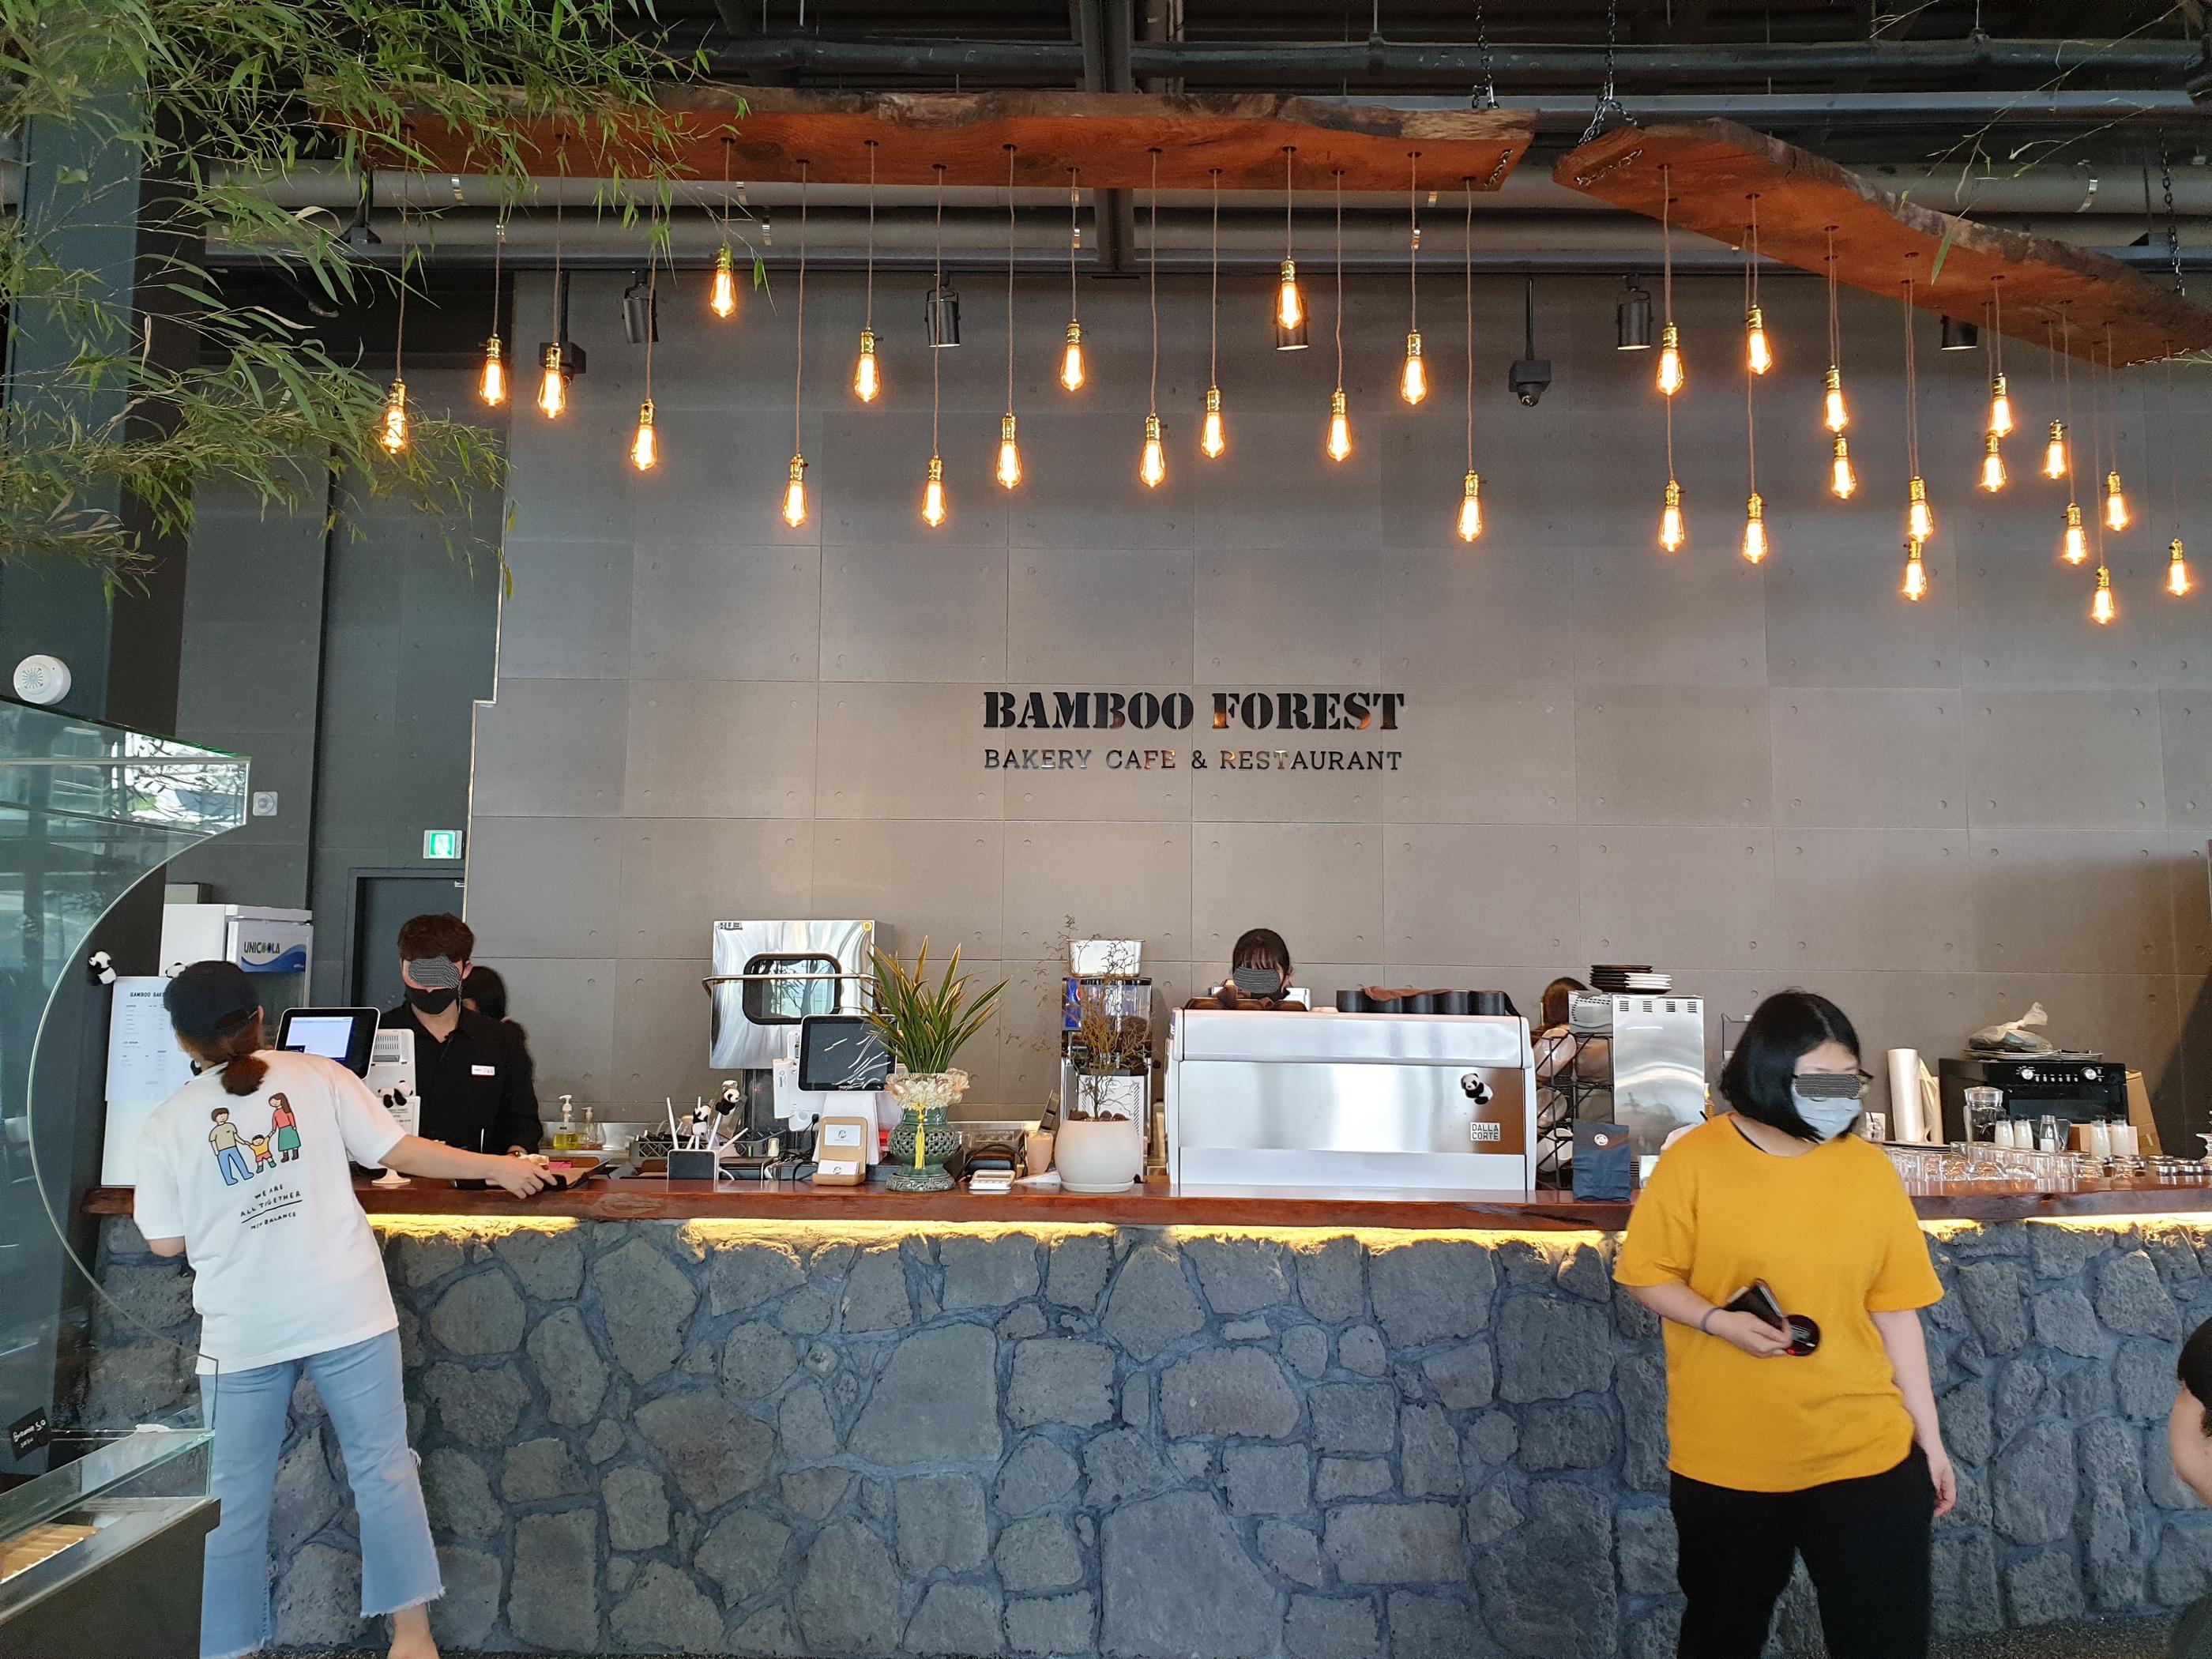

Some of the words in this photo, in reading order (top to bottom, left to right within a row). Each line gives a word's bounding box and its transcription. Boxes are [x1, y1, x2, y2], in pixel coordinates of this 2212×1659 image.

[983, 691, 1194, 729] BAMBOO
[1211, 692, 1405, 729] FOREST
[984, 750, 1092, 769] BAKERY
[1106, 750, 1176, 769] CAFE
[1191, 750, 1208, 769] &
[1220, 750, 1402, 770] RESTAURANT
[270, 1184, 284, 1194] ARE
[240, 1207, 257, 1217] ALL
